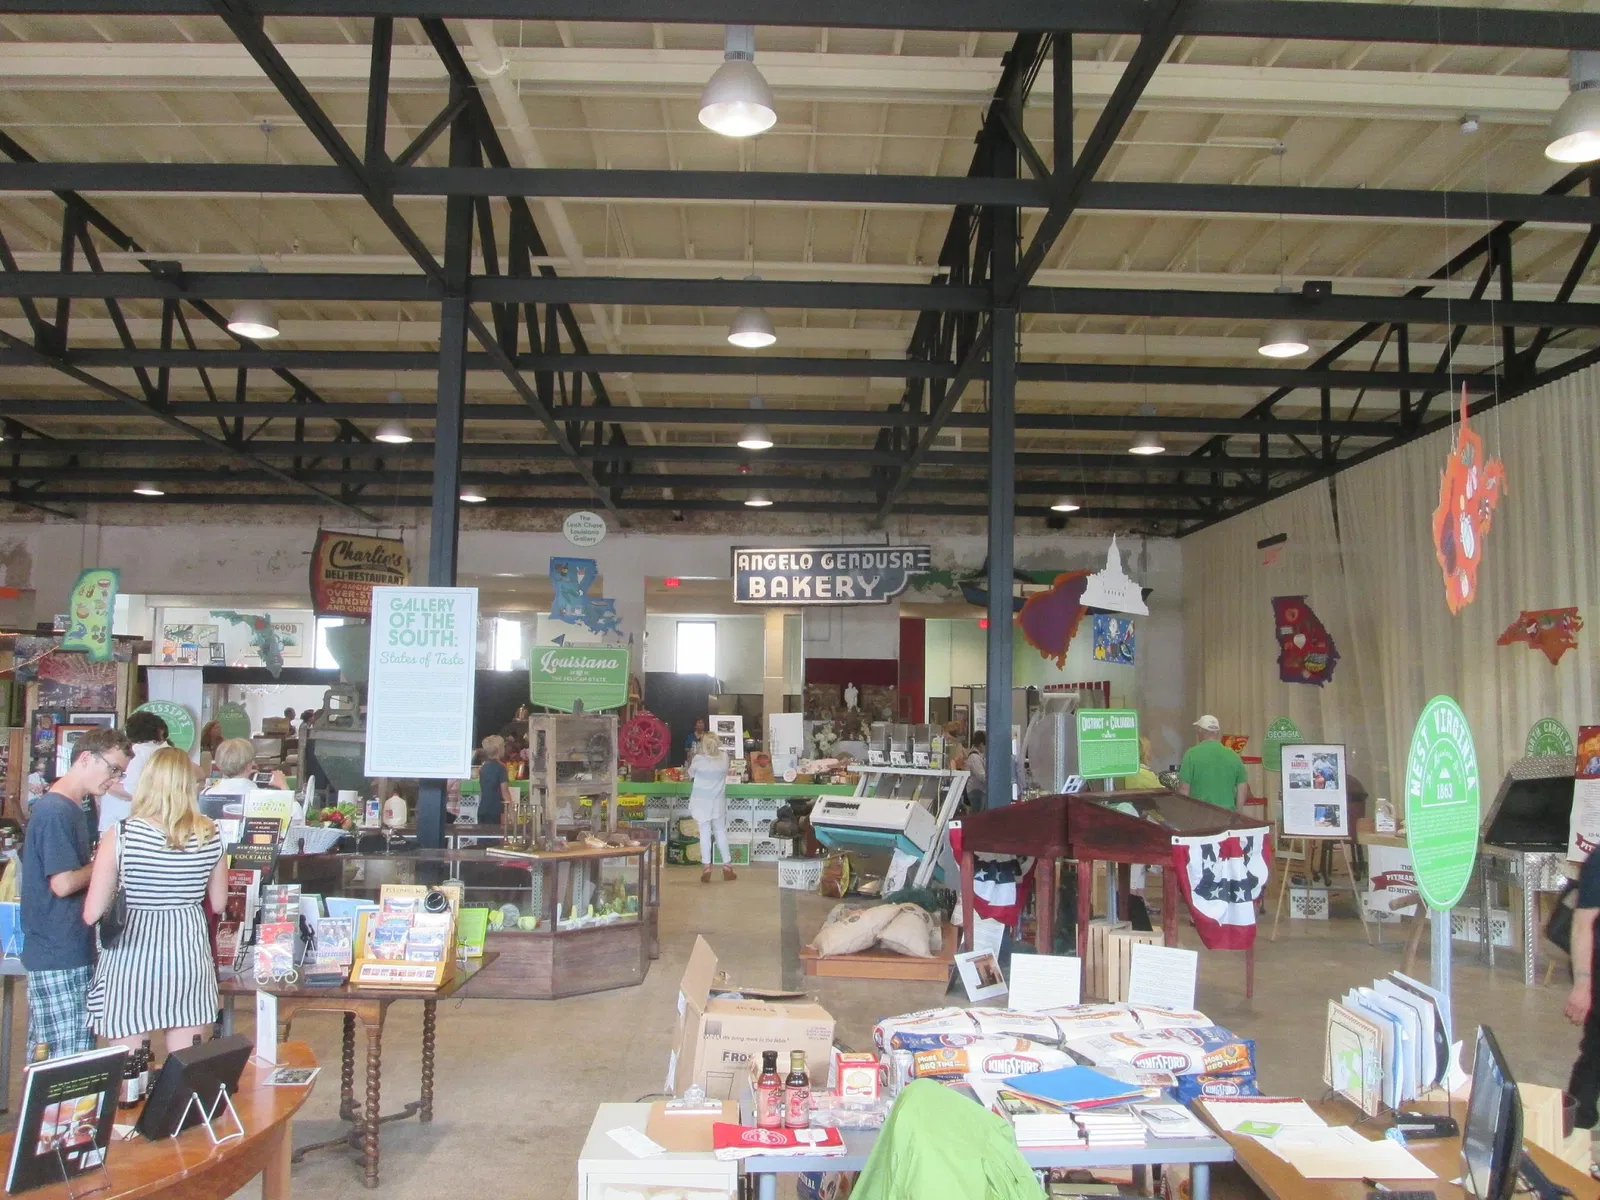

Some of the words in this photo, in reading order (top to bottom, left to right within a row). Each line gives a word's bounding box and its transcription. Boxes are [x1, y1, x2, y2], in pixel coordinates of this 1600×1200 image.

[573, 535, 596, 543] Gallery
[329, 540, 403, 570] Charlie's
[738, 553, 813, 571] ANGELO
[820, 552, 914, 570] GENDUSA
[325, 569, 404, 586] DELI-RESTAURANT
[749, 575, 881, 598] BAKERY
[326, 604, 346, 612] AND
[390, 597, 455, 612] GALLERY
[389, 612, 416, 628] OF
[421, 613, 455, 629] THE
[388, 629, 458, 647] SOUTH:
[380, 651, 417, 665] States
[419, 652, 432, 668] of
[434, 652, 464, 665] Taste
[540, 650, 620, 674] Louisiana
[1081, 717, 1104, 731] DISTRICT
[1110, 716, 1135, 730] COLUMBIA
[1267, 730, 1300, 738] GEORGIA
[1410, 725, 1430, 796] WEST
[1433, 708, 1476, 791] VIRGINIA
[1436, 783, 1452, 799] 1863
[917, 1054, 937, 1063] MORE
[919, 1061, 936, 1071] BBQ
[988, 1057, 1040, 1074] KINGSFORD
[1136, 1054, 1186, 1073] KINGSFORD
[1205, 1083, 1237, 1096] KINGSFORD
